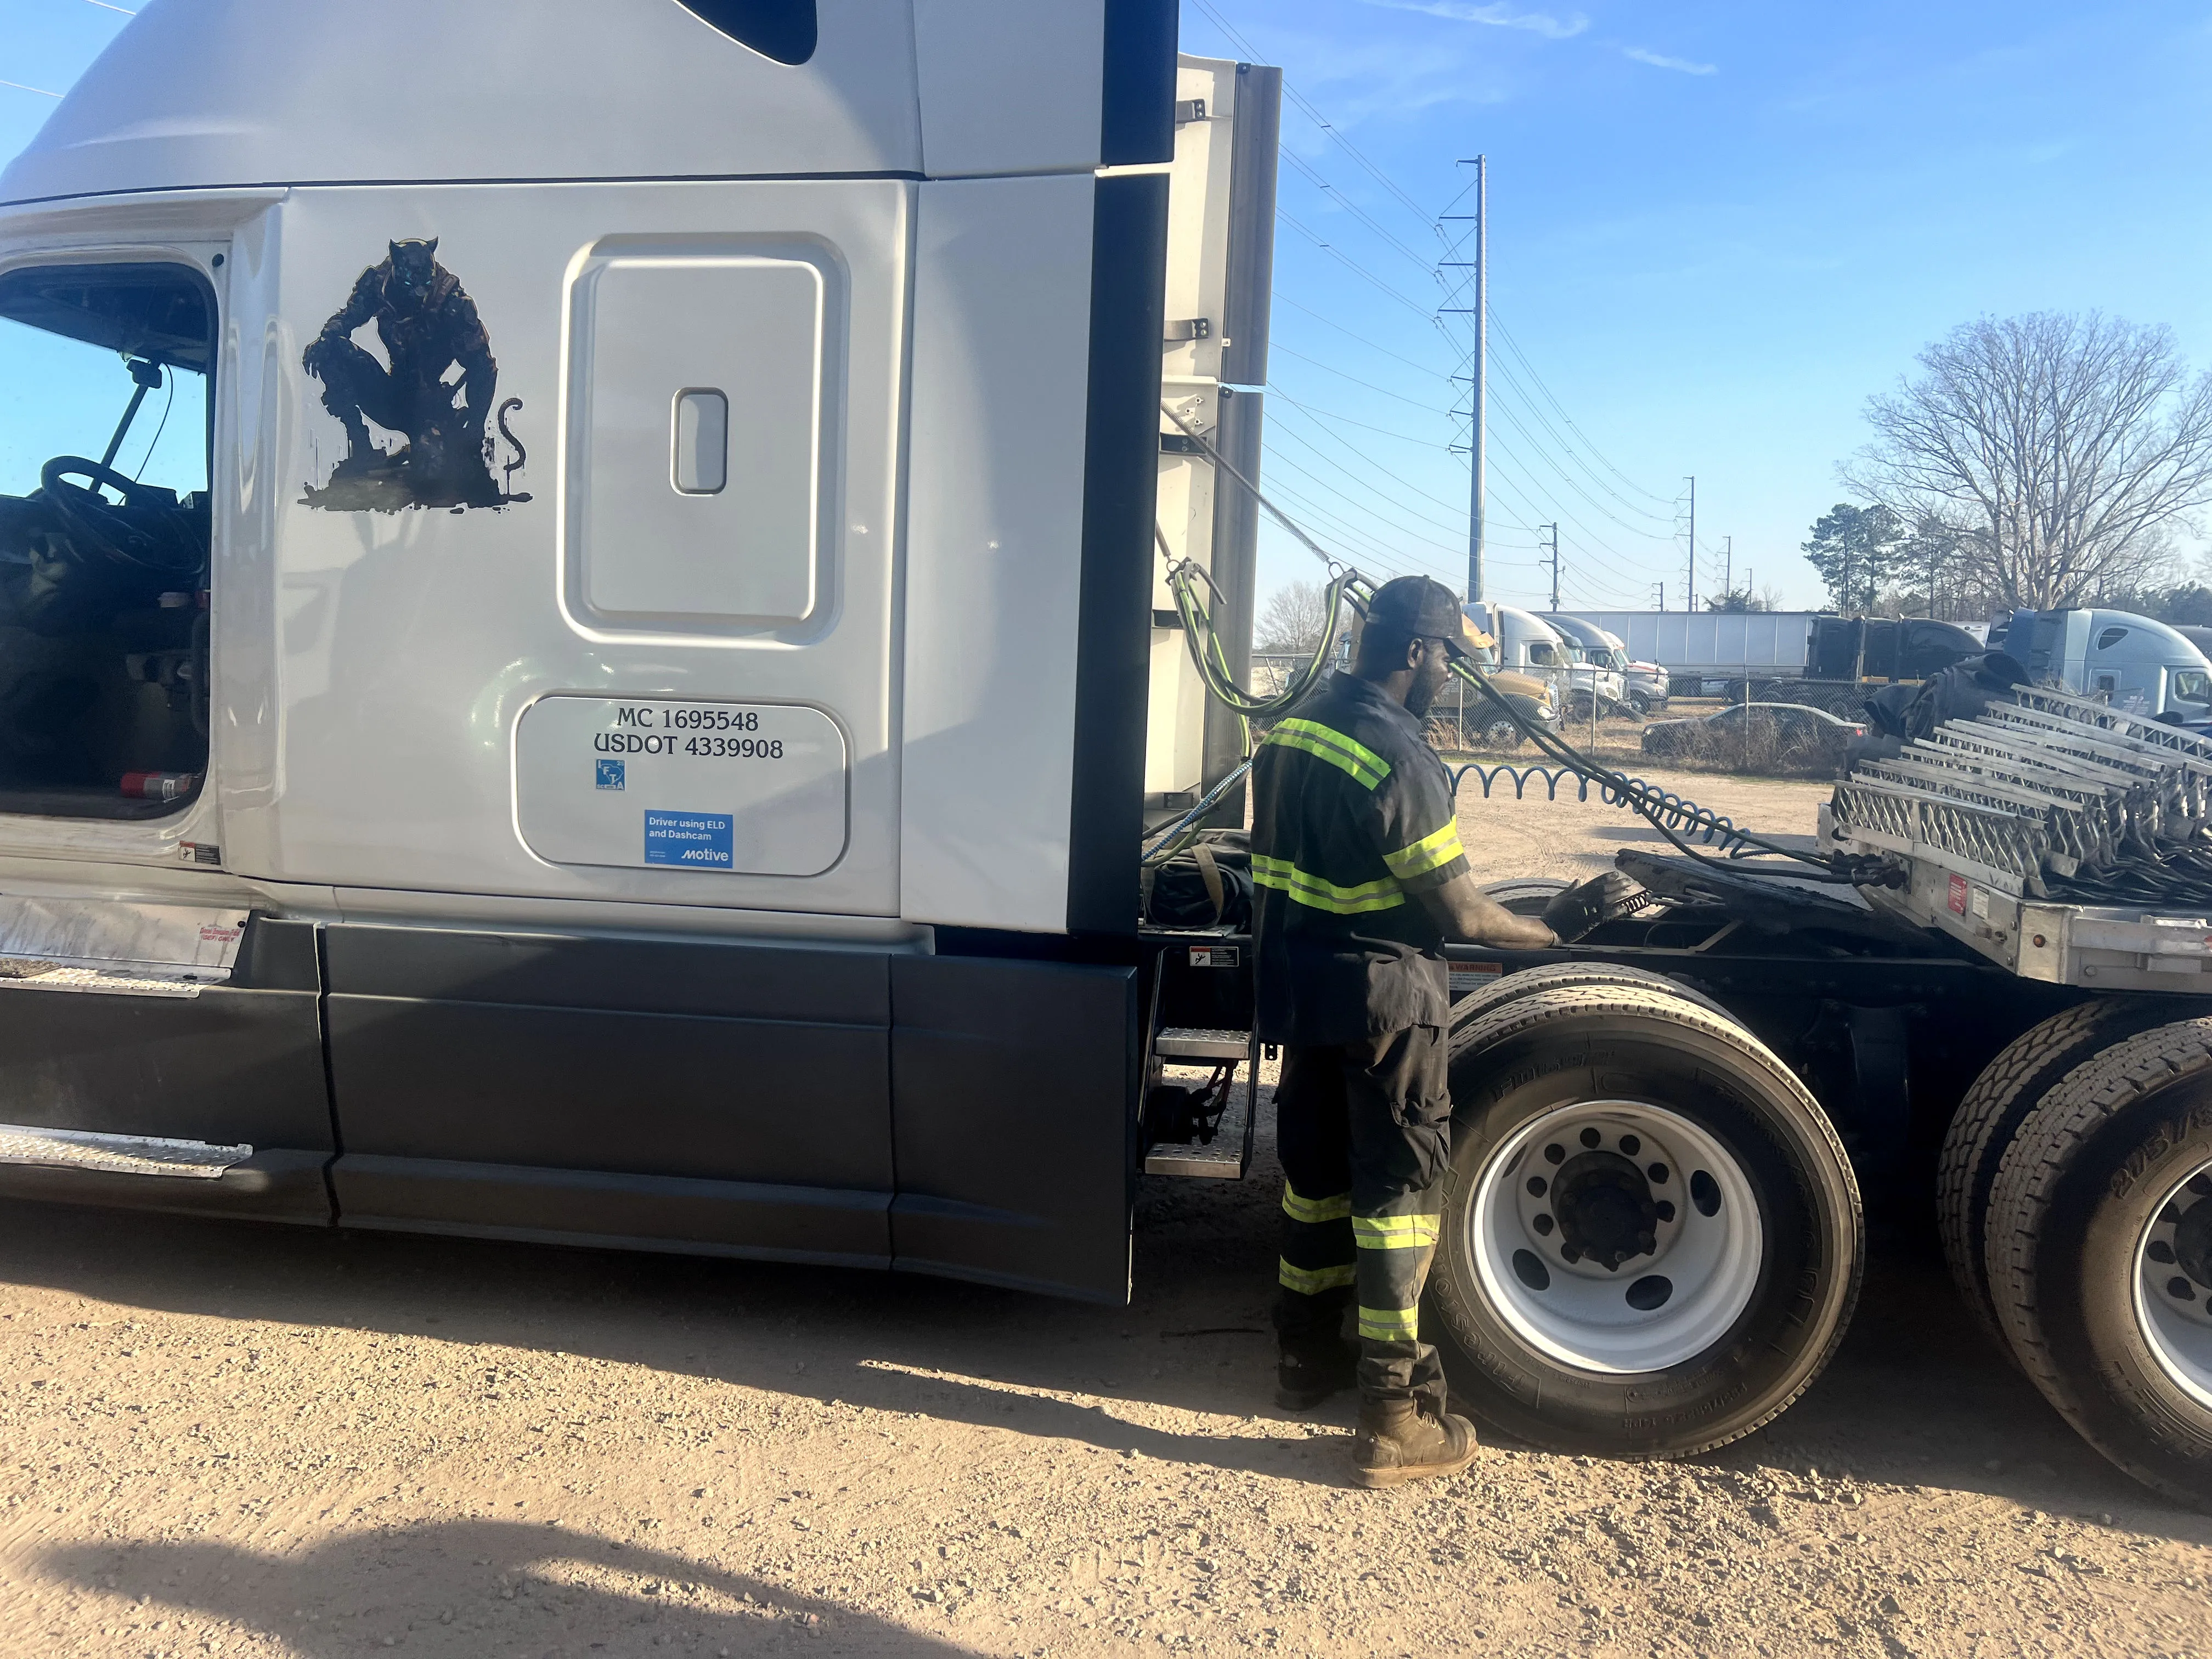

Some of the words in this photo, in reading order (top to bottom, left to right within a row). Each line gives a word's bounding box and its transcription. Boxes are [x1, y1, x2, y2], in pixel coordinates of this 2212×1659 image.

[617, 708, 653, 727] MC
[663, 709, 758, 731] 1695548
[594, 733, 678, 754] USDOT
[685, 737, 783, 759] 4339908
[649, 817, 678, 826] Driver
[679, 819, 705, 830] using
[707, 821, 725, 830] ELD
[649, 830, 666, 838] and
[668, 830, 712, 840] Dashcam
[1429, 1234, 1525, 1394] Fireston
